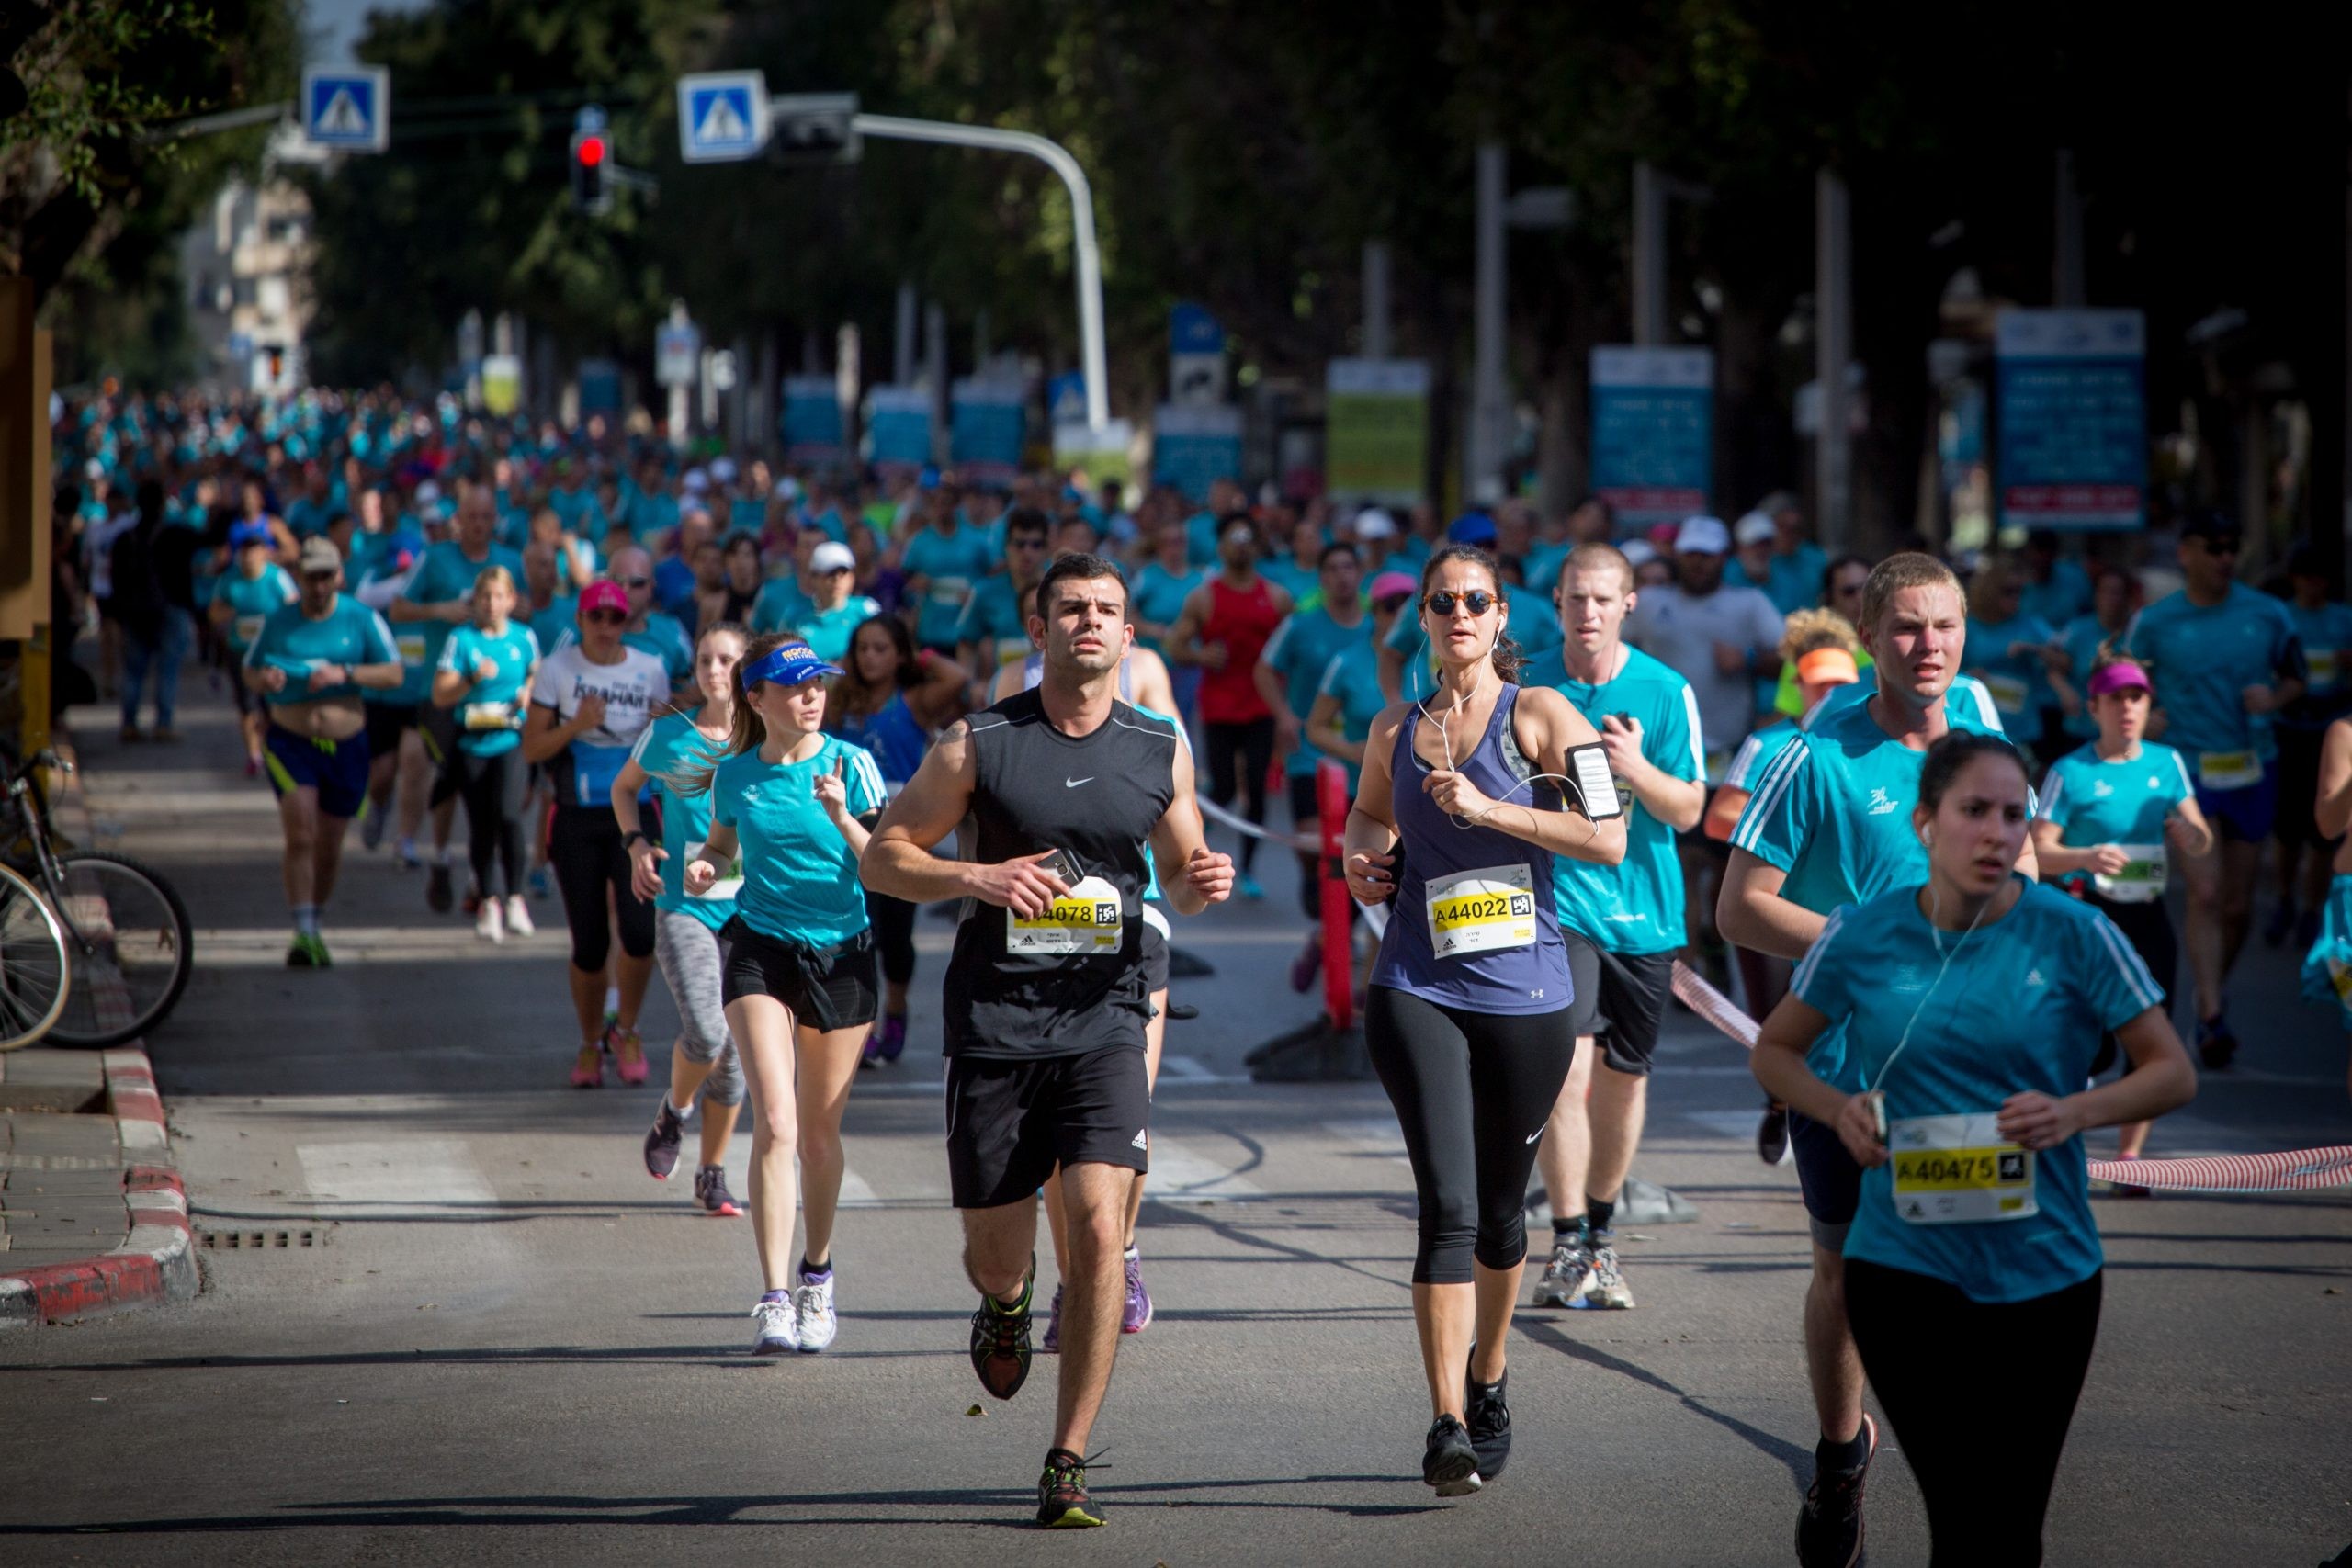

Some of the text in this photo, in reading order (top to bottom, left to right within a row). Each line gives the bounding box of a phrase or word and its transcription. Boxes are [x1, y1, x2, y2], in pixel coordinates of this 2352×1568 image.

[1036, 906, 1091, 922] 4078
[1435, 899, 1508, 923] A44022
[1897, 1156, 1993, 1183] A40475
